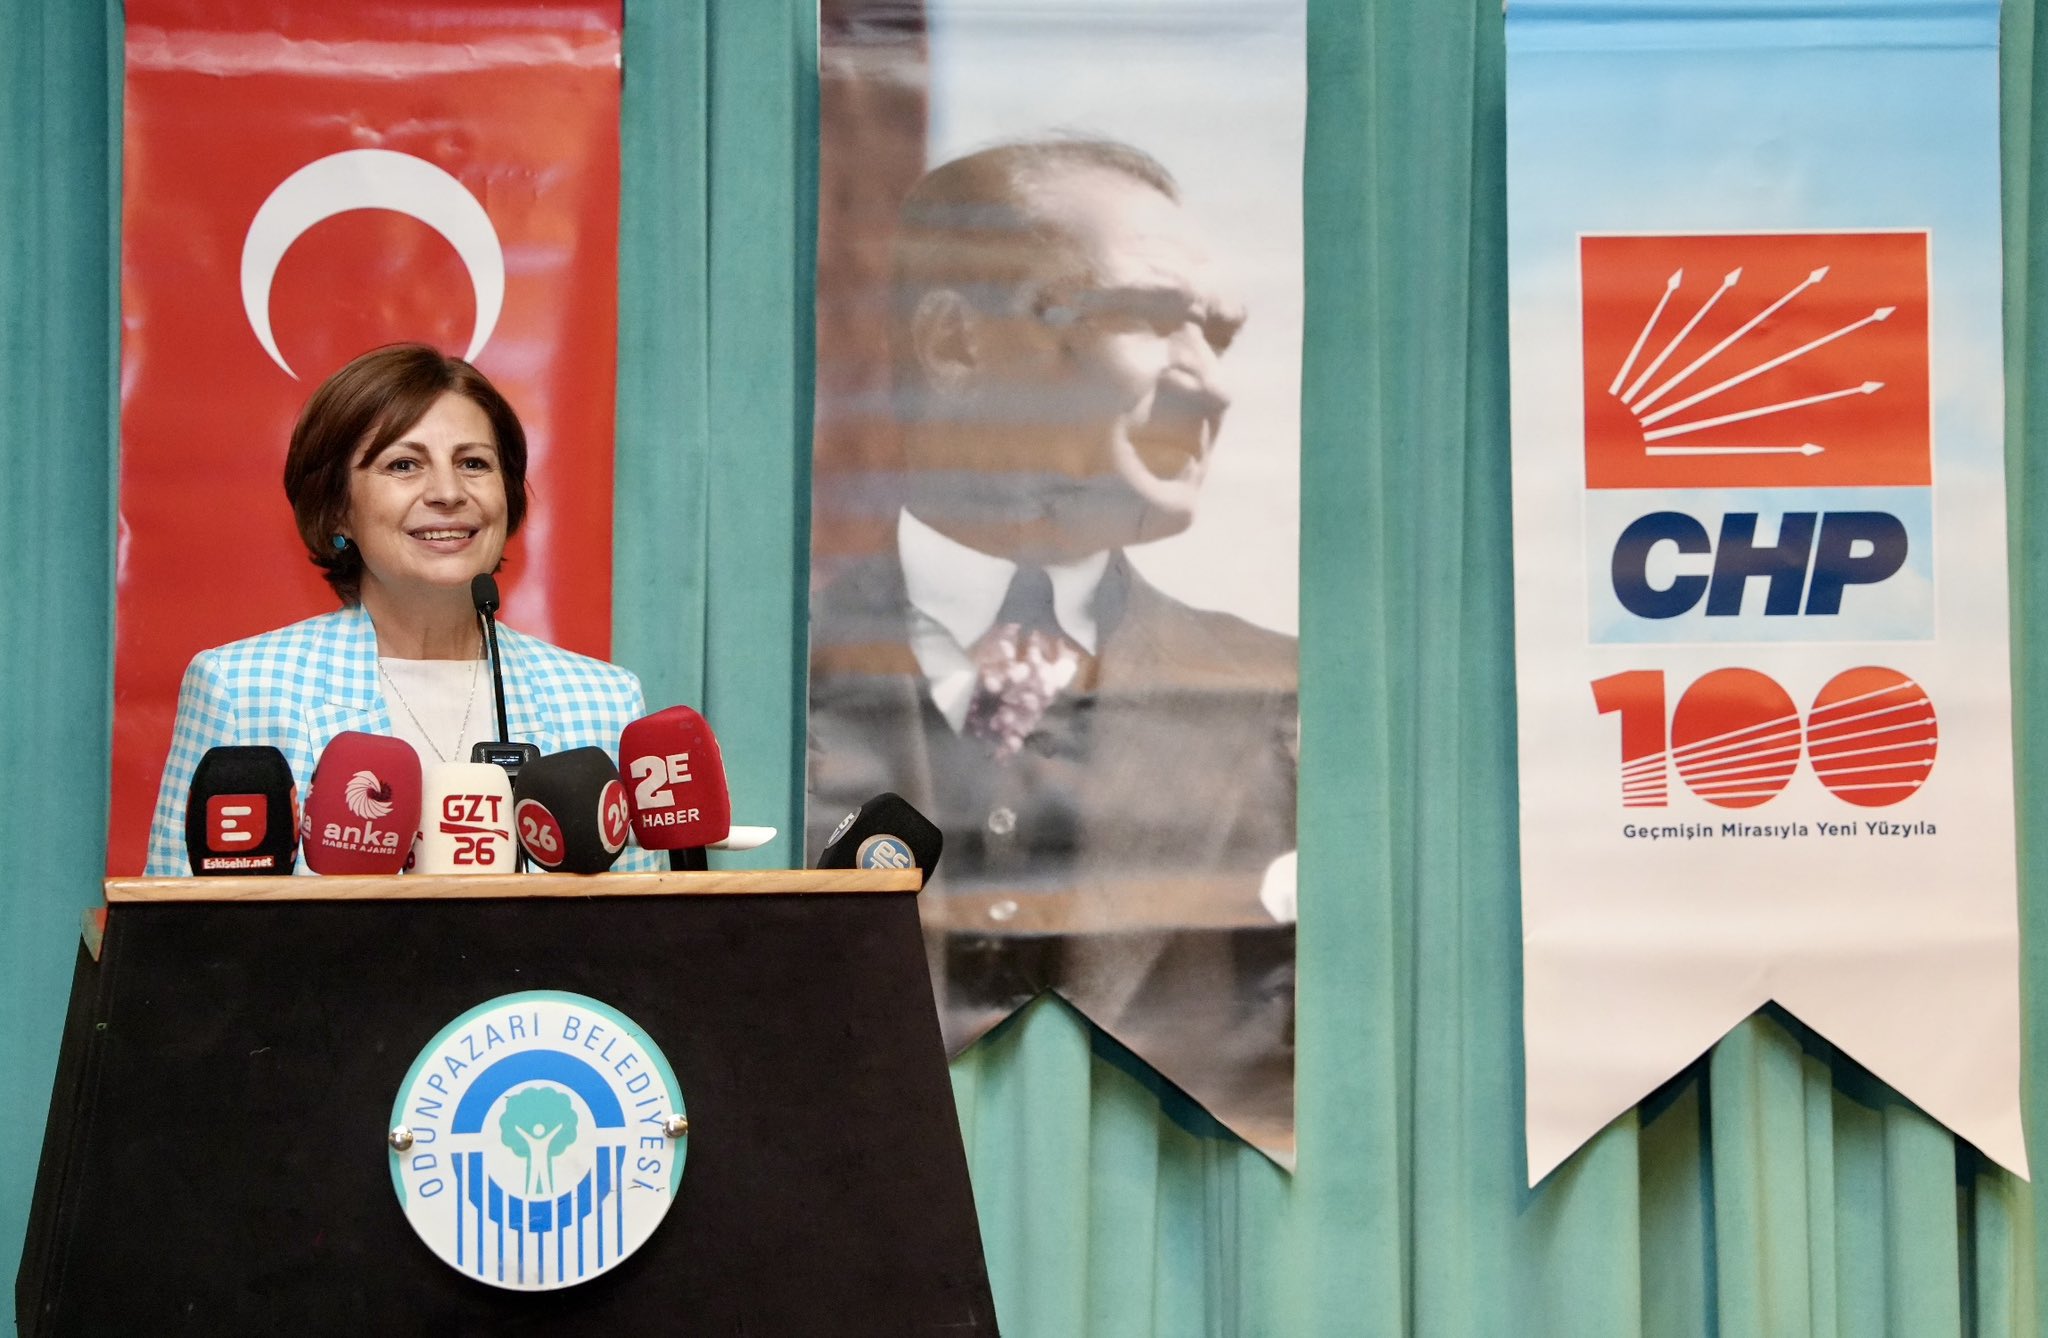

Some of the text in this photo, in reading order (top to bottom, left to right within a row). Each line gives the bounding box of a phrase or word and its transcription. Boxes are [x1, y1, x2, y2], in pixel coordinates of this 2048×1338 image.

[1611, 510, 1909, 620] CHP
[1590, 665, 1939, 810] 100
[630, 753, 692, 809] 2E
[220, 806, 252, 842] E
[443, 794, 503, 823] GZT
[608, 791, 628, 836] 26
[643, 808, 700, 828] HABER
[322, 838, 397, 855] HABER AJANSI
[323, 820, 400, 849] anka
[523, 816, 558, 852] 26
[1623, 820, 1937, 841] Geçmişin Mirasıyla Yeni Yüzyıla
[203, 857, 272, 870] Eskisehir.net
[453, 836, 496, 866] 26
[412, 1012, 665, 1199] ODUNPAZARI BELEDİYESİ
